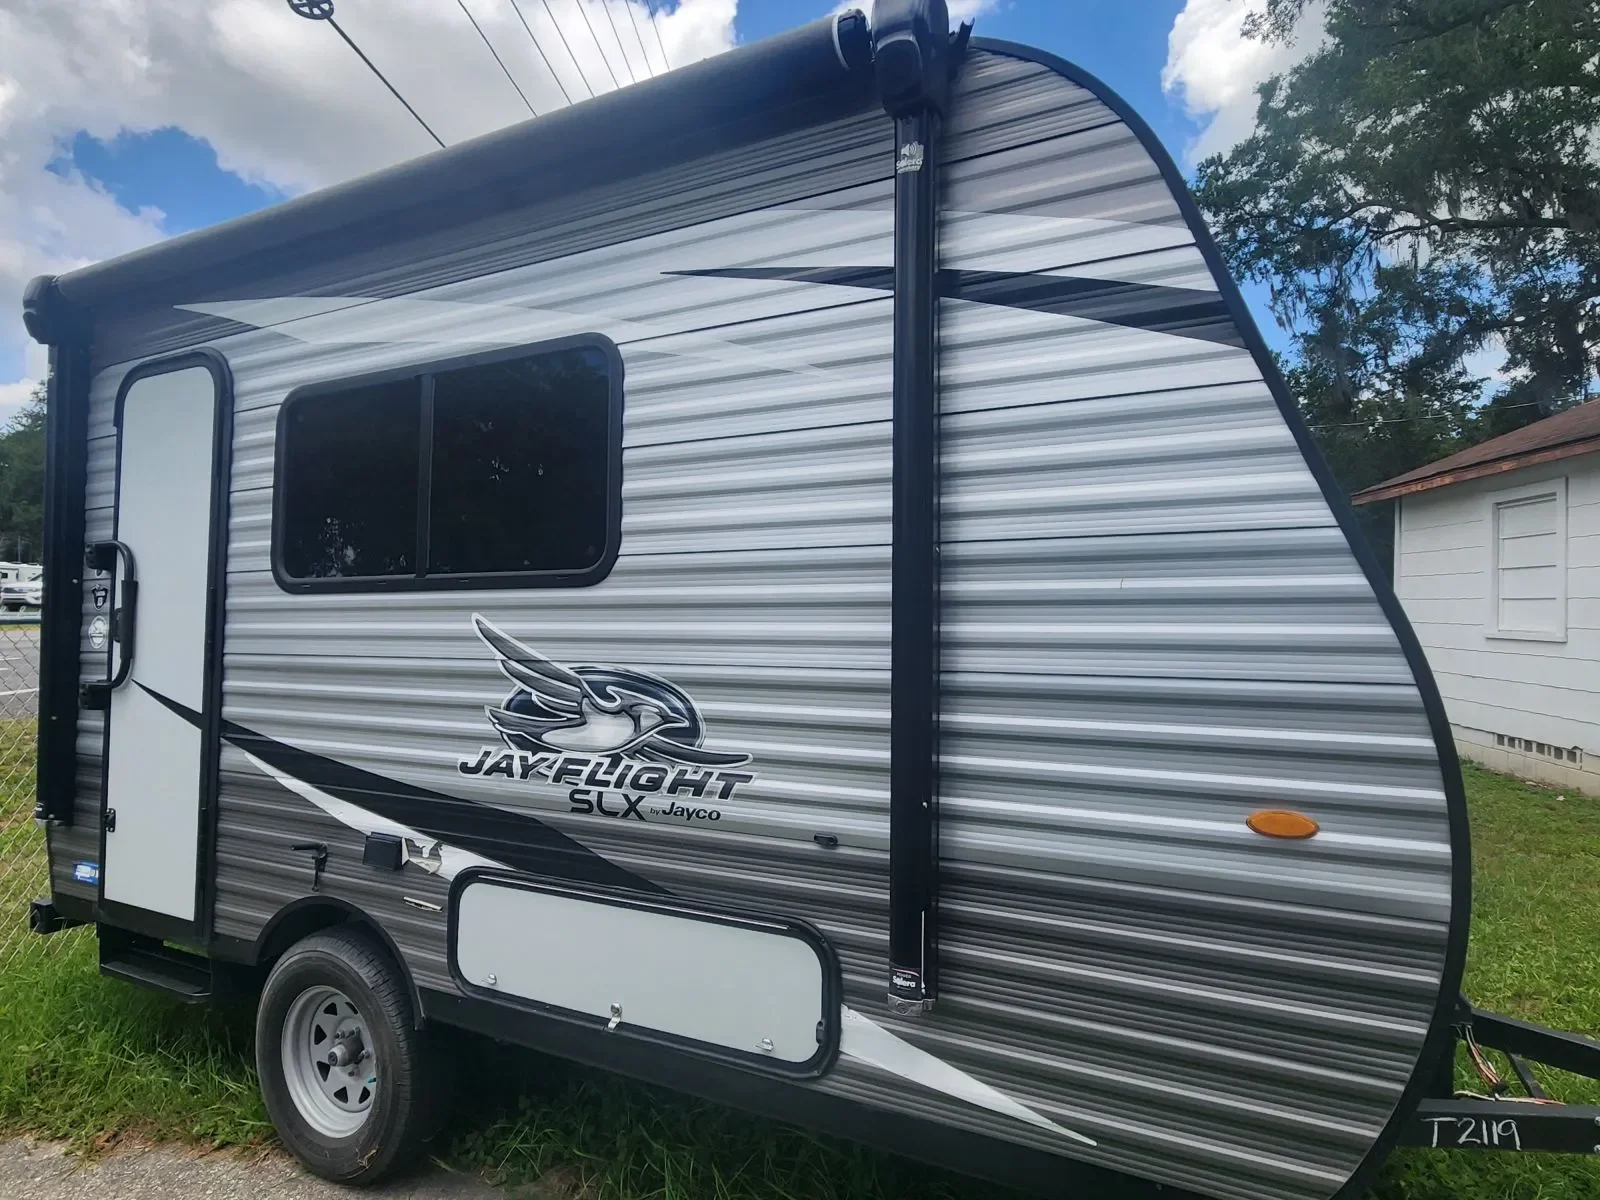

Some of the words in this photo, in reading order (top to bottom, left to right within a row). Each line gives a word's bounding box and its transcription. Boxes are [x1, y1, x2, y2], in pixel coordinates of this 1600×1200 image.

[458, 749, 551, 781] JAY
[551, 756, 755, 800] FLIGHT
[569, 788, 646, 822] SLX
[650, 807, 661, 816] by
[662, 801, 721, 821] Jayco
[1420, 1116, 1521, 1151] T2119
